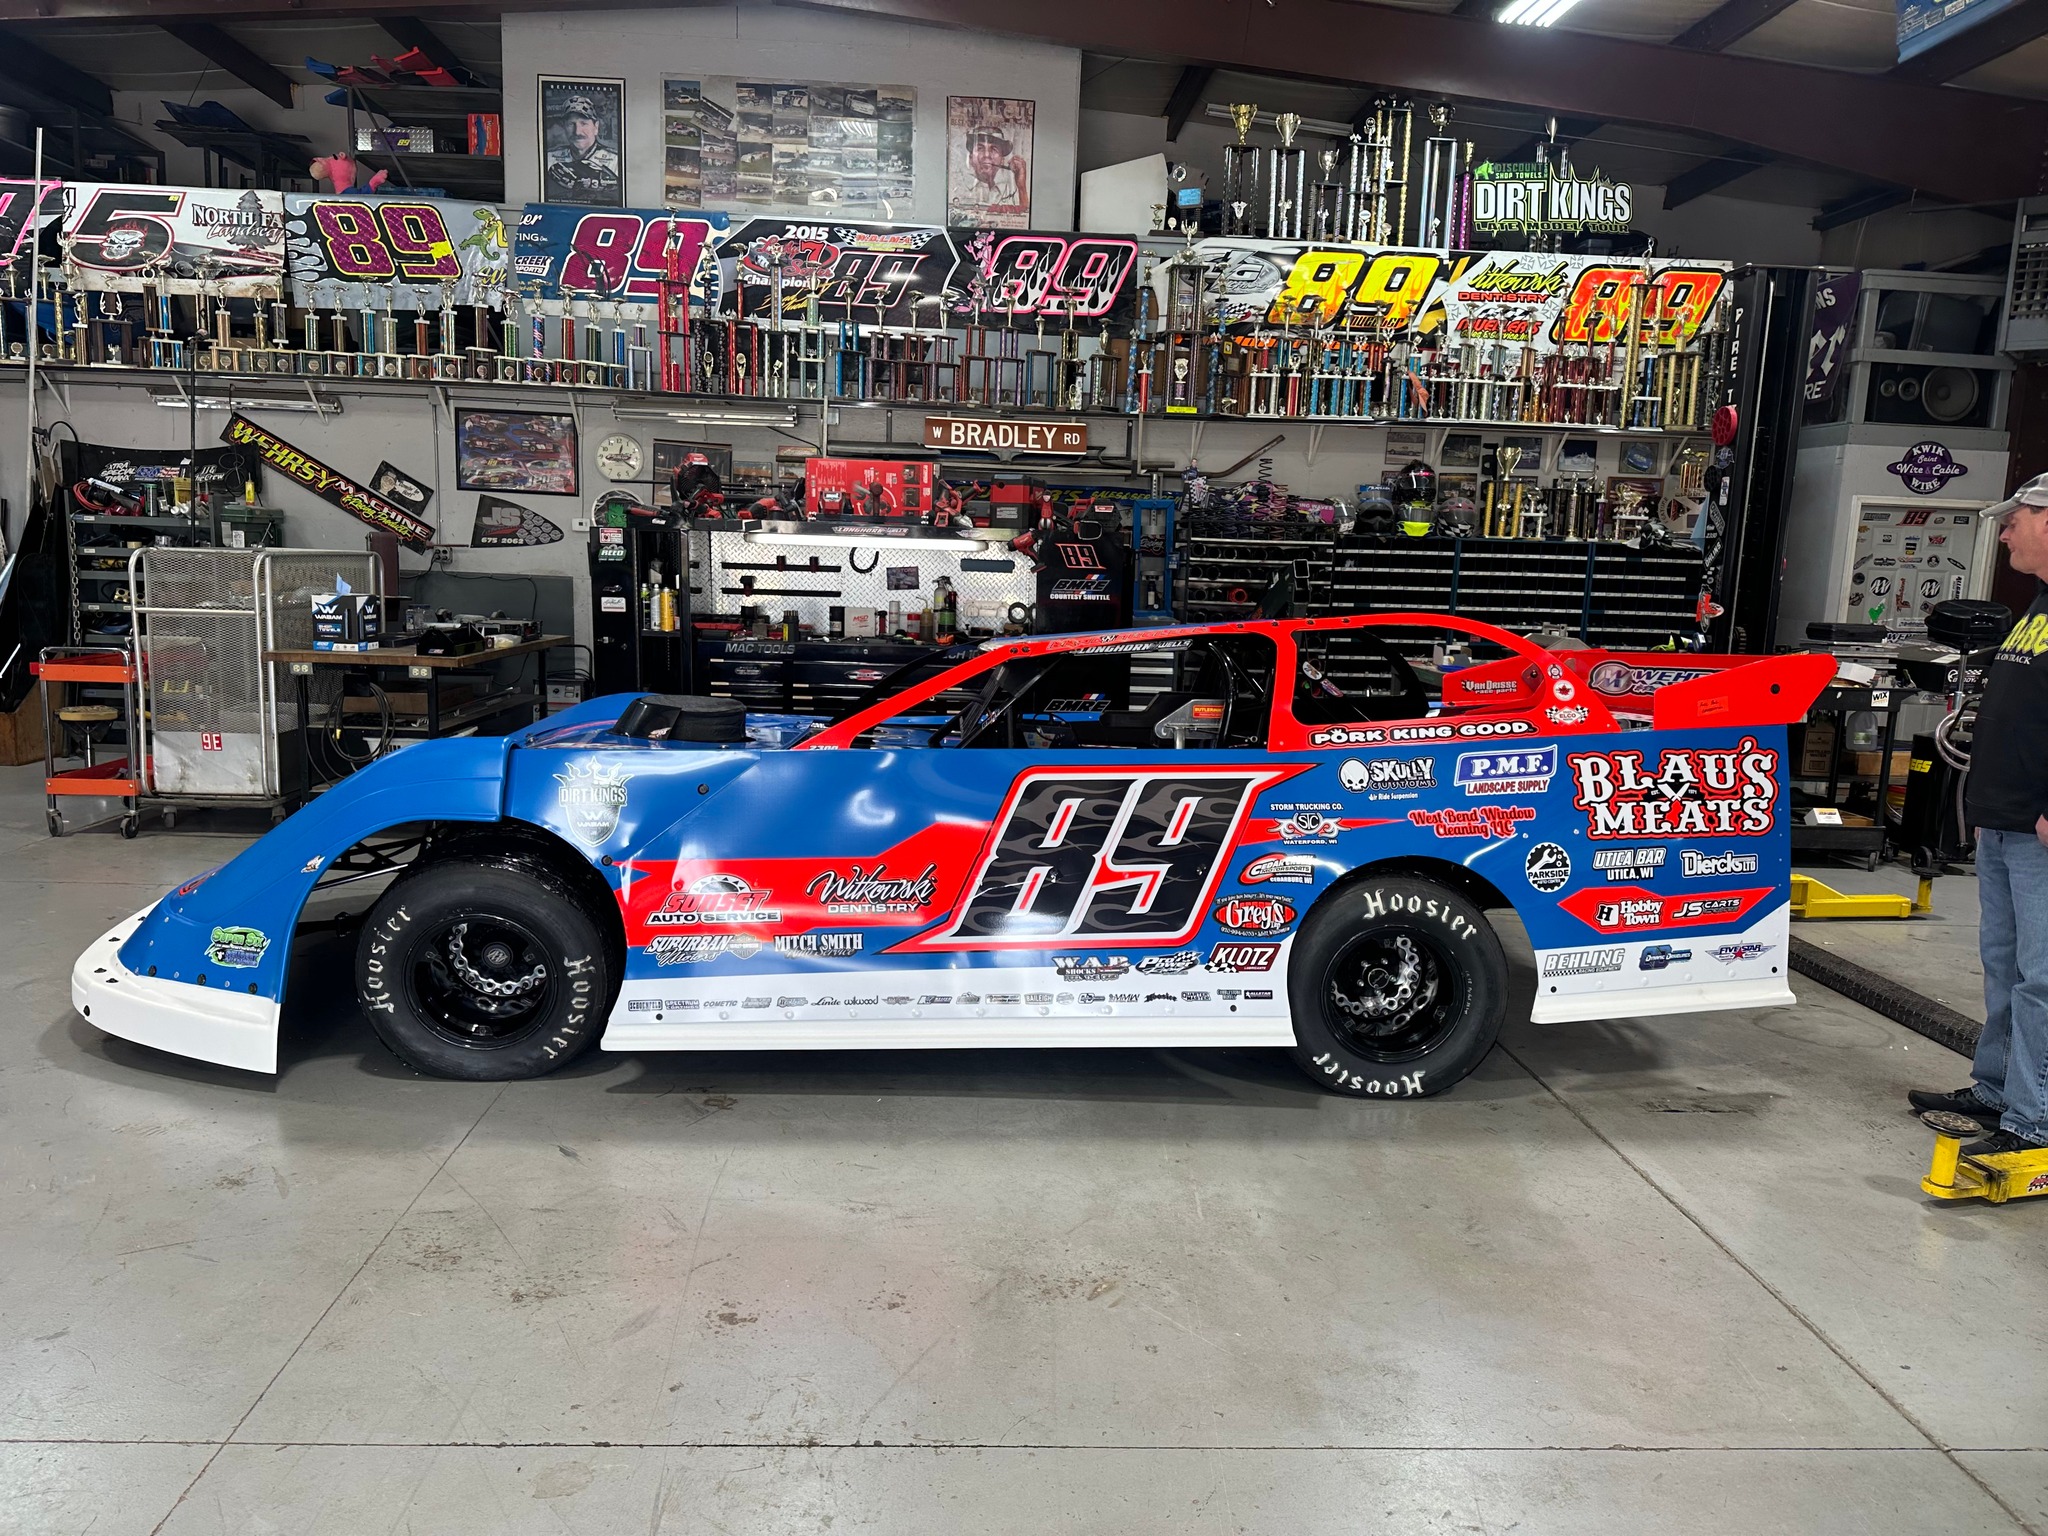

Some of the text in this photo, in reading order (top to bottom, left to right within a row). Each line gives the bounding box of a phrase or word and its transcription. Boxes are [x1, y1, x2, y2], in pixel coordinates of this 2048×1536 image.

[1496, 162, 1543, 172] DISCOUNT
[1475, 180, 1633, 224] DIRT KINGS
[192, 204, 254, 228] NORTH
[784, 225, 829, 241] 2015
[1475, 221, 1630, 234] LATE MODEL TOUR
[313, 201, 463, 278] 89
[515, 255, 550, 266] CREEK
[559, 213, 711, 296] 89
[818, 251, 928, 308] 89
[982, 236, 1138, 316] 89
[1266, 250, 1440, 330] 89
[1458, 291, 1551, 304] DENTISTRY
[1552, 266, 1725, 345] 89
[932, 422, 1081, 450] W BRADLEY RD
[1912, 444, 1946, 457] KWIK
[1896, 463, 1924, 475] Wire
[1932, 464, 1960, 476] Cable
[1911, 477, 1941, 490] WIRE
[335, 480, 430, 538] MACHINE
[481, 507, 521, 527] JS
[1898, 509, 1936, 527] 89
[501, 537, 524, 545] 2062
[1055, 543, 1107, 570] 89
[1052, 579, 1111, 591] BMRE
[853, 614, 869, 622] MSD
[725, 643, 795, 654] MAC TOOLS
[1079, 640, 1190, 654] LONGHORN WELLS
[1044, 698, 1112, 712] BMRE
[1871, 691, 1889, 703] WIX
[1390, 725, 1452, 741] KING
[1460, 722, 1531, 736] GOOD
[1370, 758, 1433, 782] SKULLY
[1471, 754, 1549, 778] P.M.F.
[1572, 740, 1775, 806] BLAU'S
[1372, 780, 1437, 788] CUSTOMS
[1467, 779, 1549, 794] LANDSCAPE SUPPLY
[560, 785, 627, 804] DIRT KINGS
[1391, 792, 1418, 801] Suspension
[1409, 806, 1536, 826] West Bend Window
[1589, 798, 1772, 836] MEATS
[1434, 820, 1515, 839] Cleaning LLC
[945, 770, 1264, 943] 89
[1596, 848, 1667, 868] UTICA BAR
[1682, 852, 1756, 876] Diercks LTD
[1528, 869, 1569, 879] PARKSIDE
[1607, 867, 1654, 881] UTICA, WI
[806, 863, 938, 905] Witkowski
[663, 890, 773, 913] SUNSET
[828, 902, 918, 914] DENTISTRY
[1620, 899, 1663, 915] Hobby
[1672, 901, 1703, 919] JS
[1704, 897, 1741, 908] CARTS
[650, 911, 779, 924] AUTO SERVICE
[1226, 899, 1285, 930] Greg's
[1363, 888, 1478, 940] Hoosier
[1623, 912, 1660, 926] Town
[213, 929, 245, 945] SUPER
[647, 935, 732, 952] SUBURBAN
[774, 933, 863, 952] MITCH SMITH
[657, 948, 719, 967] Motors
[815, 945, 856, 957] Service
[1214, 947, 1275, 966] KLOTZ
[1741, 944, 1762, 952] STAR
[363, 904, 411, 1014] Hoosier
[1139, 956, 1171, 969] Pro
[1155, 960, 1194, 969] Power
[1544, 948, 1626, 971] BEHLING
[1596, 965, 1622, 973] EQUIPMENT
[543, 954, 597, 1059] Hoosier
[811, 996, 841, 1006] Linde
[1312, 1052, 1427, 1097] Hoosier
